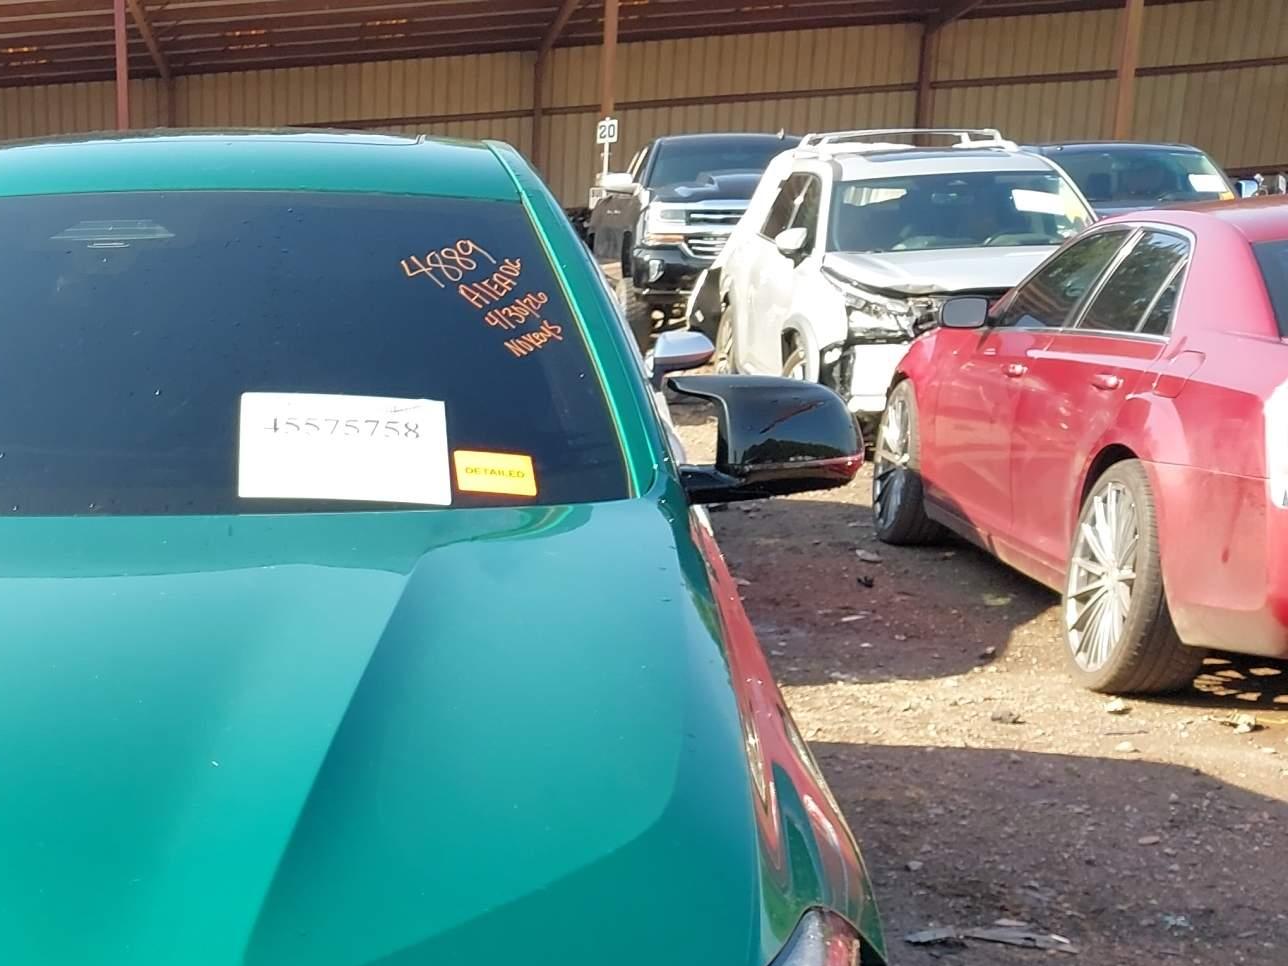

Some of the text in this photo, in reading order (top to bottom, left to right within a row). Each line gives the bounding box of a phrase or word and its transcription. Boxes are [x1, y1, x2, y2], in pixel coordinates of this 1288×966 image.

[599, 124, 616, 139] 20
[400, 239, 497, 288] 4889
[263, 416, 421, 440] 45575758
[464, 465, 526, 480] DETAILED
